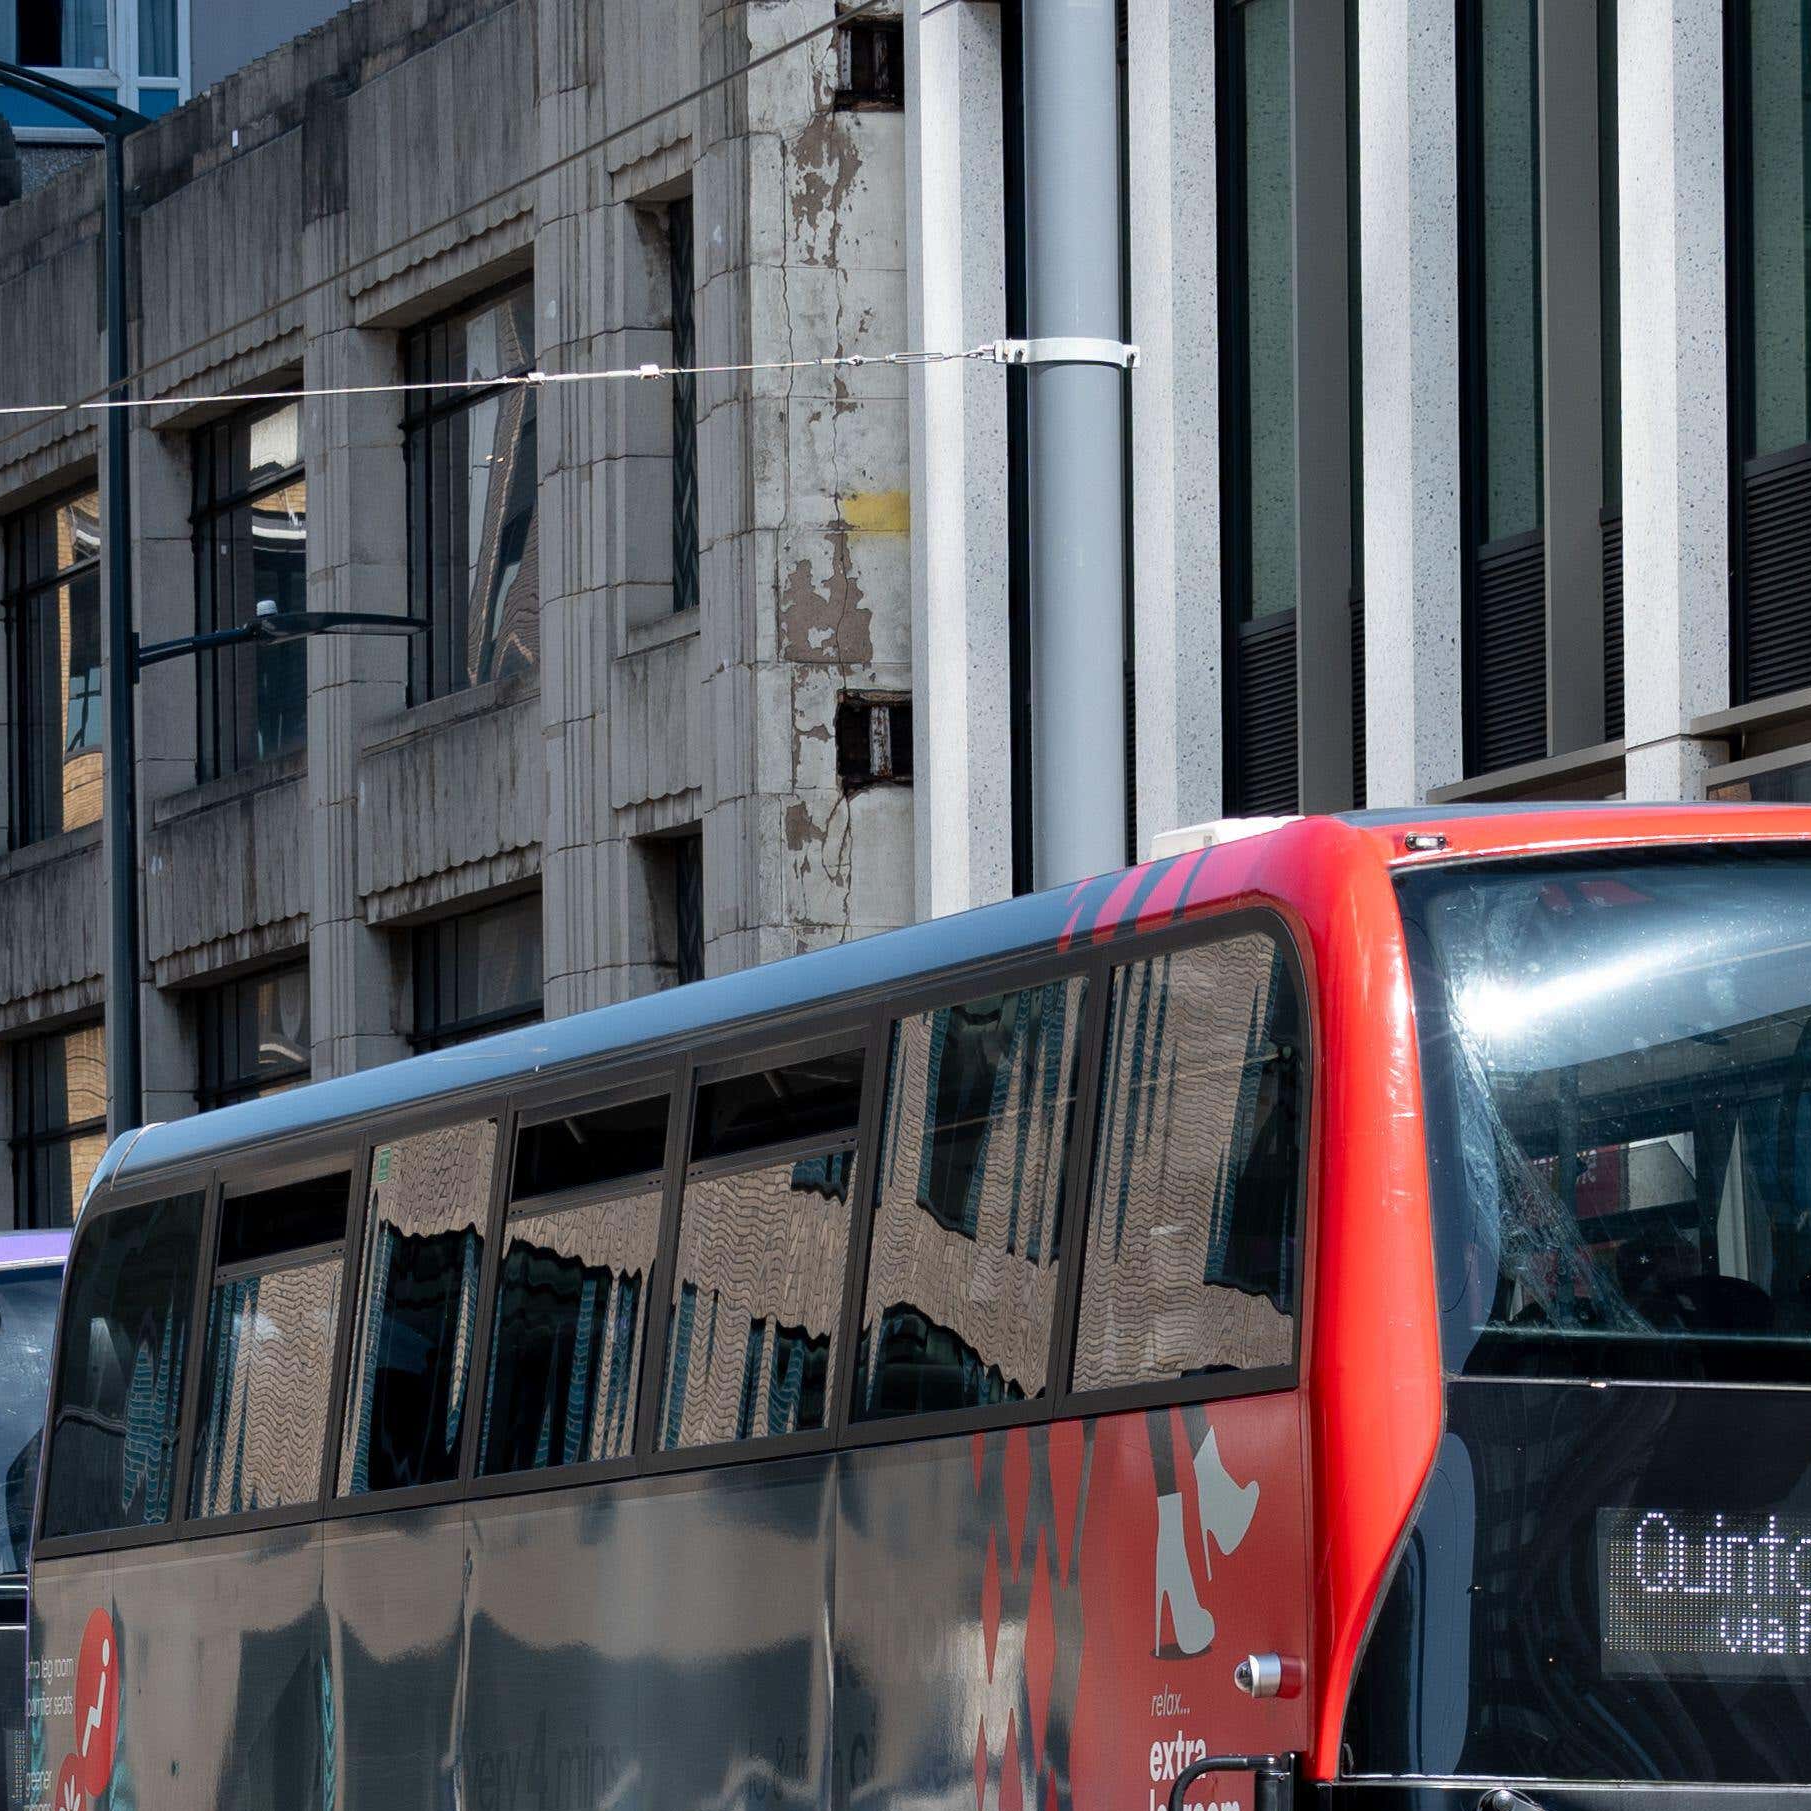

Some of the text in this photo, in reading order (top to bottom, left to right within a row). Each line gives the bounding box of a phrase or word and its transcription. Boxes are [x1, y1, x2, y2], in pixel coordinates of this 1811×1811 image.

[1719, 1602, 1785, 1656] via
[1151, 1683, 1191, 1717] relax...
[1150, 1730, 1207, 1782] extra
